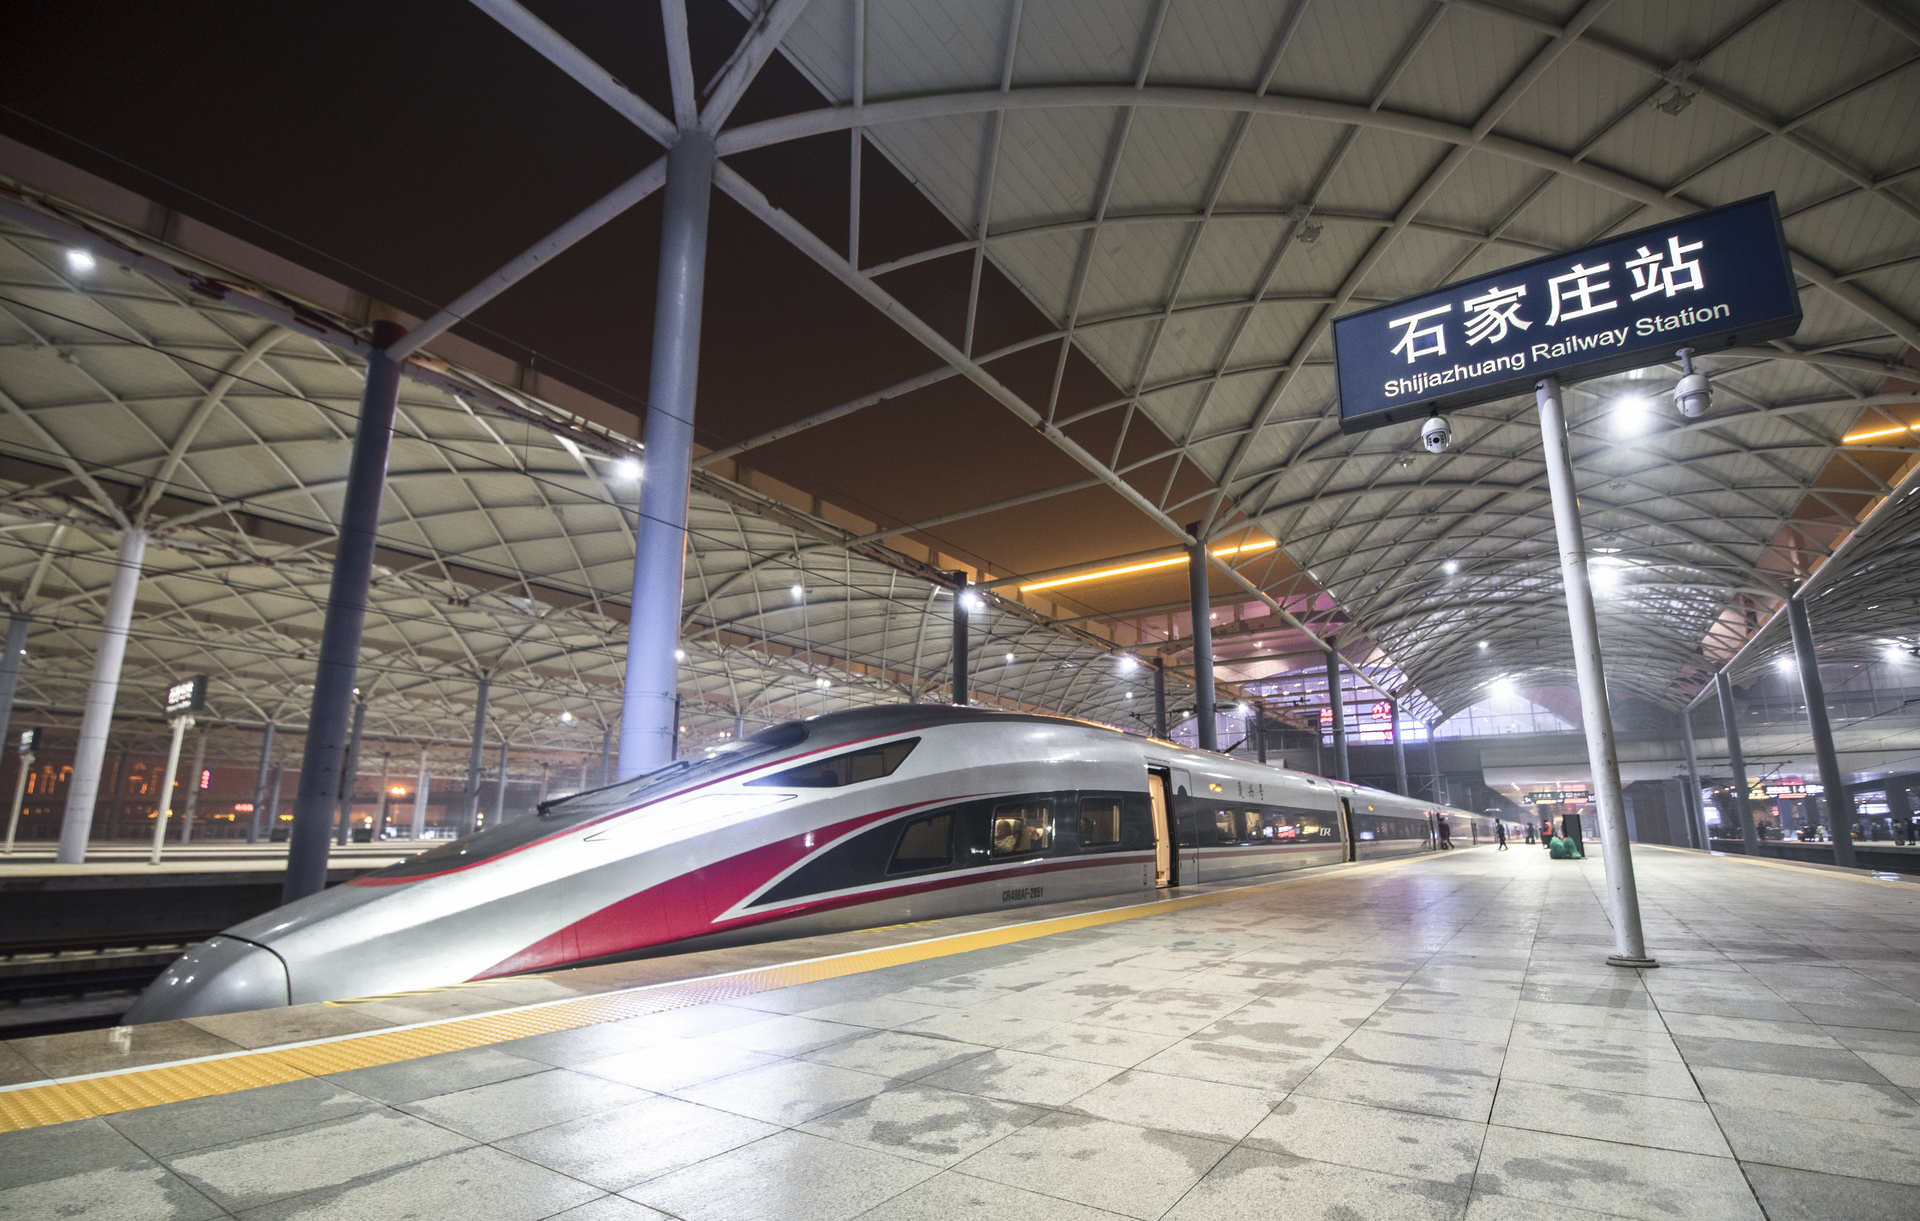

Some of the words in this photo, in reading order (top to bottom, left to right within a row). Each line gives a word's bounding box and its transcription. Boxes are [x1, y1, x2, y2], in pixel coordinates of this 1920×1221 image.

[1383, 351, 1526, 399] Shijiazhuang
[1531, 324, 1630, 363] Railway
[1635, 300, 1731, 338] Station
[1388, 235, 1705, 365] 石家庄站
